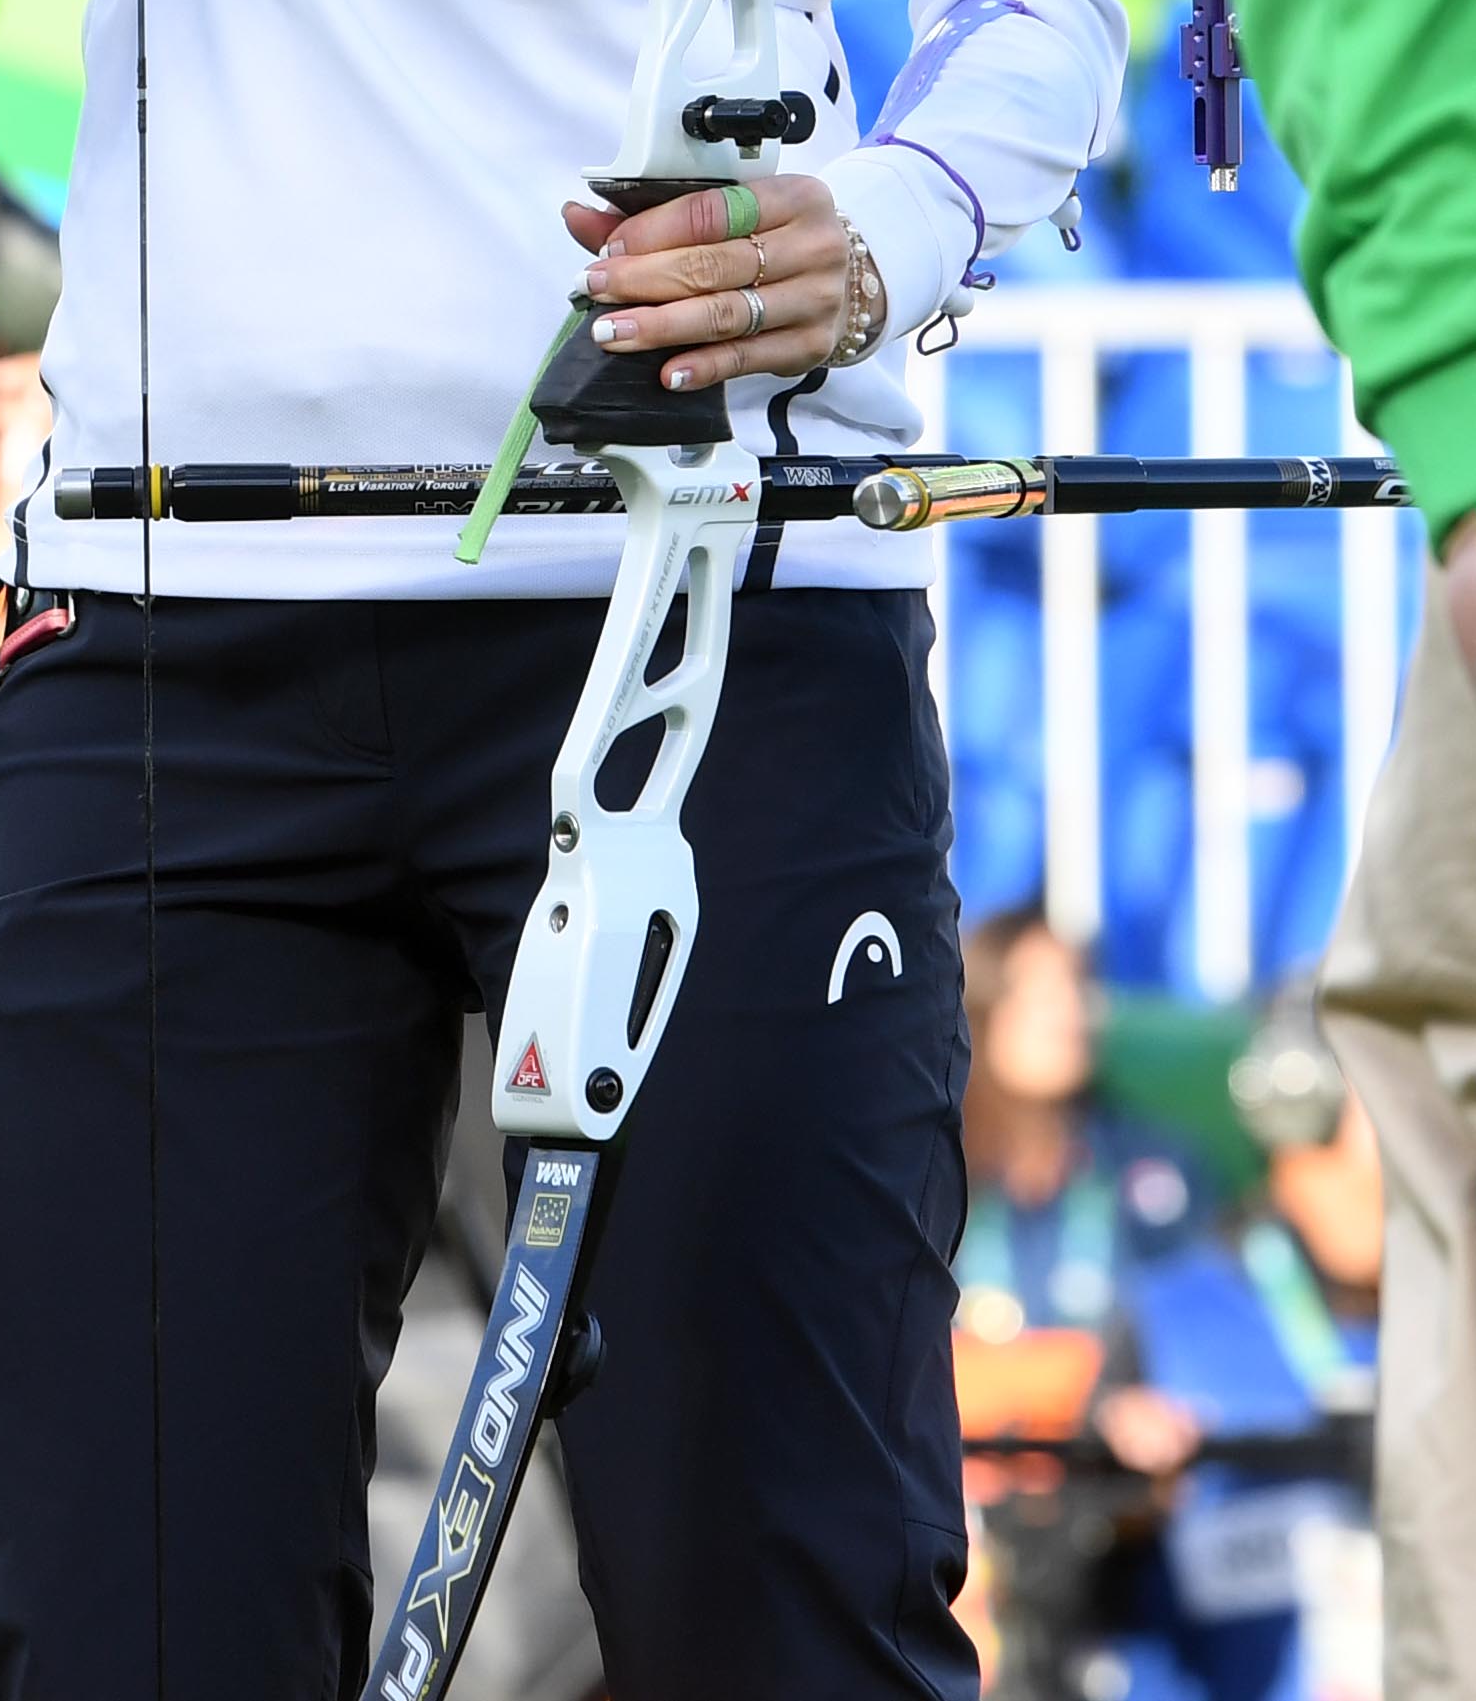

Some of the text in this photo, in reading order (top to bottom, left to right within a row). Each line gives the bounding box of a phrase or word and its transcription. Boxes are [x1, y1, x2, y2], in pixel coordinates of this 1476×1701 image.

[782, 466, 834, 487] W&W
[517, 1074, 541, 1087] OFC
[536, 1161, 581, 1187] W&W
[530, 1226, 561, 1237] NANO
[471, 1261, 550, 1468] INNO
